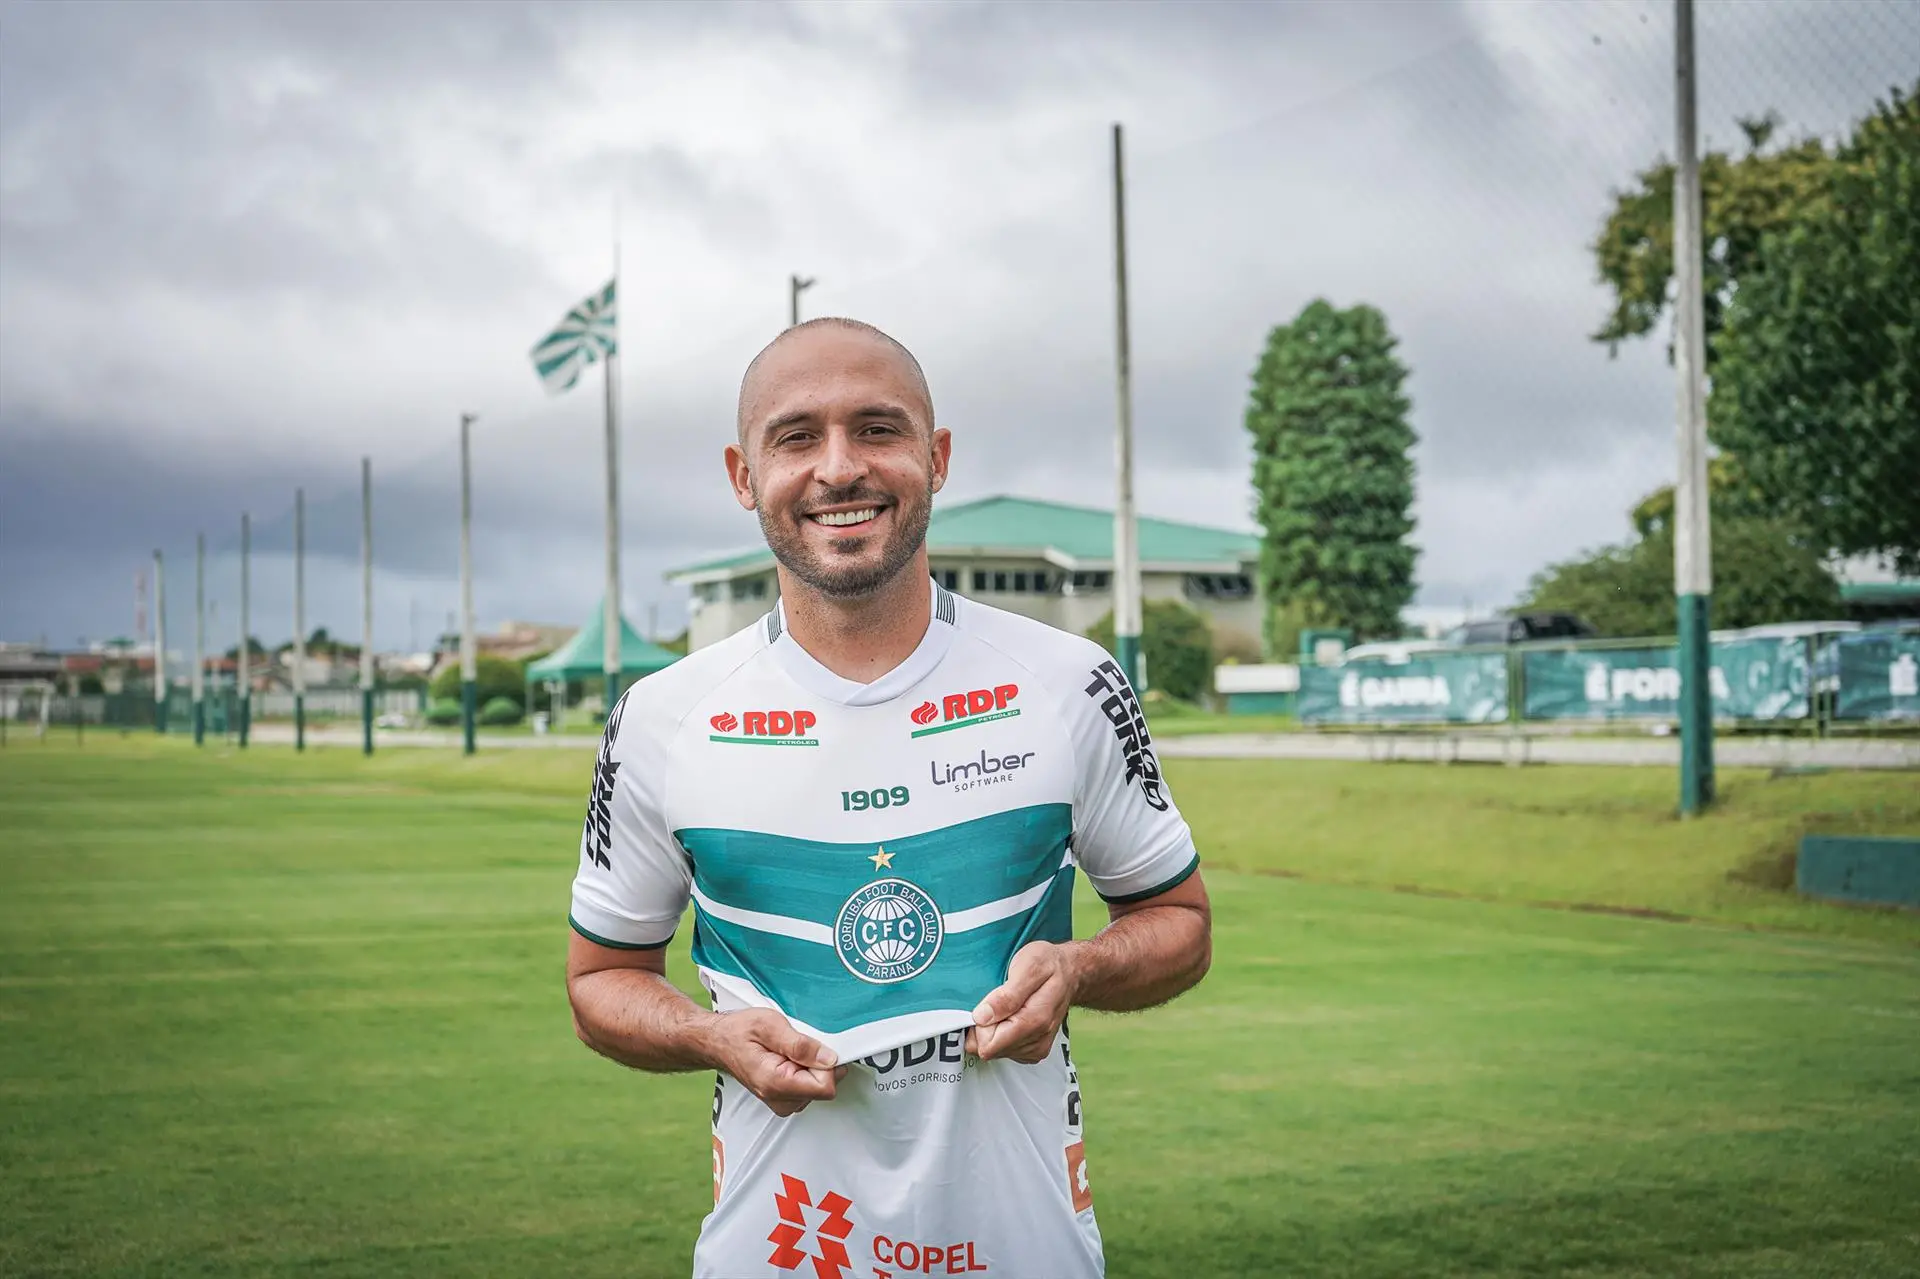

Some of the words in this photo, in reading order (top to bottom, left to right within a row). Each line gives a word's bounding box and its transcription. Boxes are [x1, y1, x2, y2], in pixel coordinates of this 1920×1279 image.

[1611, 667, 1731, 700] FORA
[943, 684, 1019, 722] RDP
[743, 710, 817, 737] RDP
[1084, 669, 1144, 786] TORK
[931, 749, 1035, 786] Limber
[954, 773, 1014, 793] SOFTWARE
[841, 785, 910, 812] 1909
[841, 898, 866, 951] CORITIBA
[864, 883, 898, 900] FOOT
[900, 887, 926, 912] BALL
[923, 912, 937, 944] CLUB
[866, 959, 916, 978] PARANÁ
[853, 1027, 970, 1075] ODE
[910, 1072, 962, 1086] SORRISOS
[873, 1235, 987, 1275] COPEL
